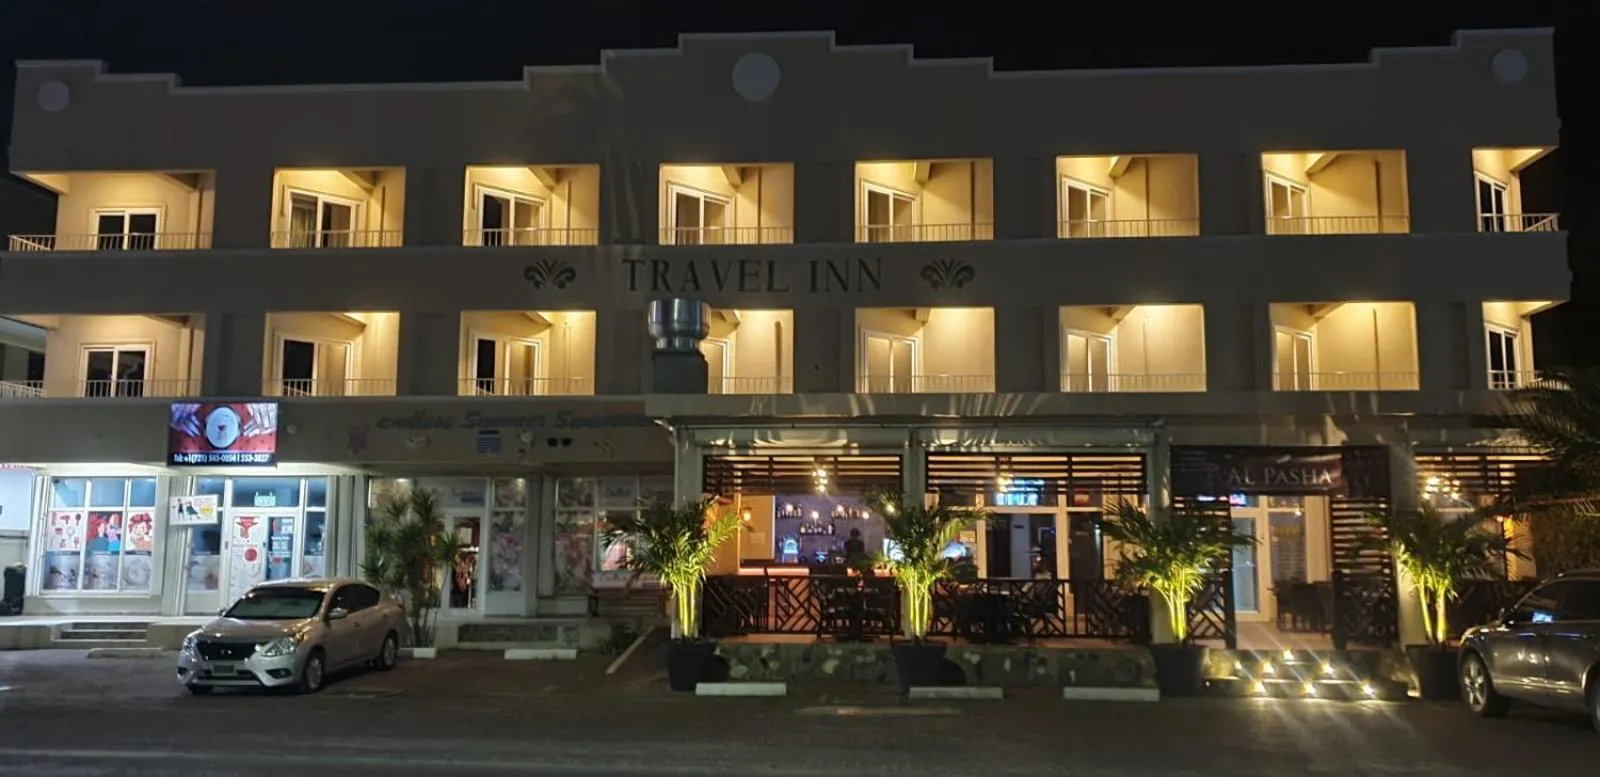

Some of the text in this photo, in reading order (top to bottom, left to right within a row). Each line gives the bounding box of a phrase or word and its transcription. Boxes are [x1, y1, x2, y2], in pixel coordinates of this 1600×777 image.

[622, 257, 883, 293] TRAVEL INN
[1227, 467, 1333, 485] AL PASHA
